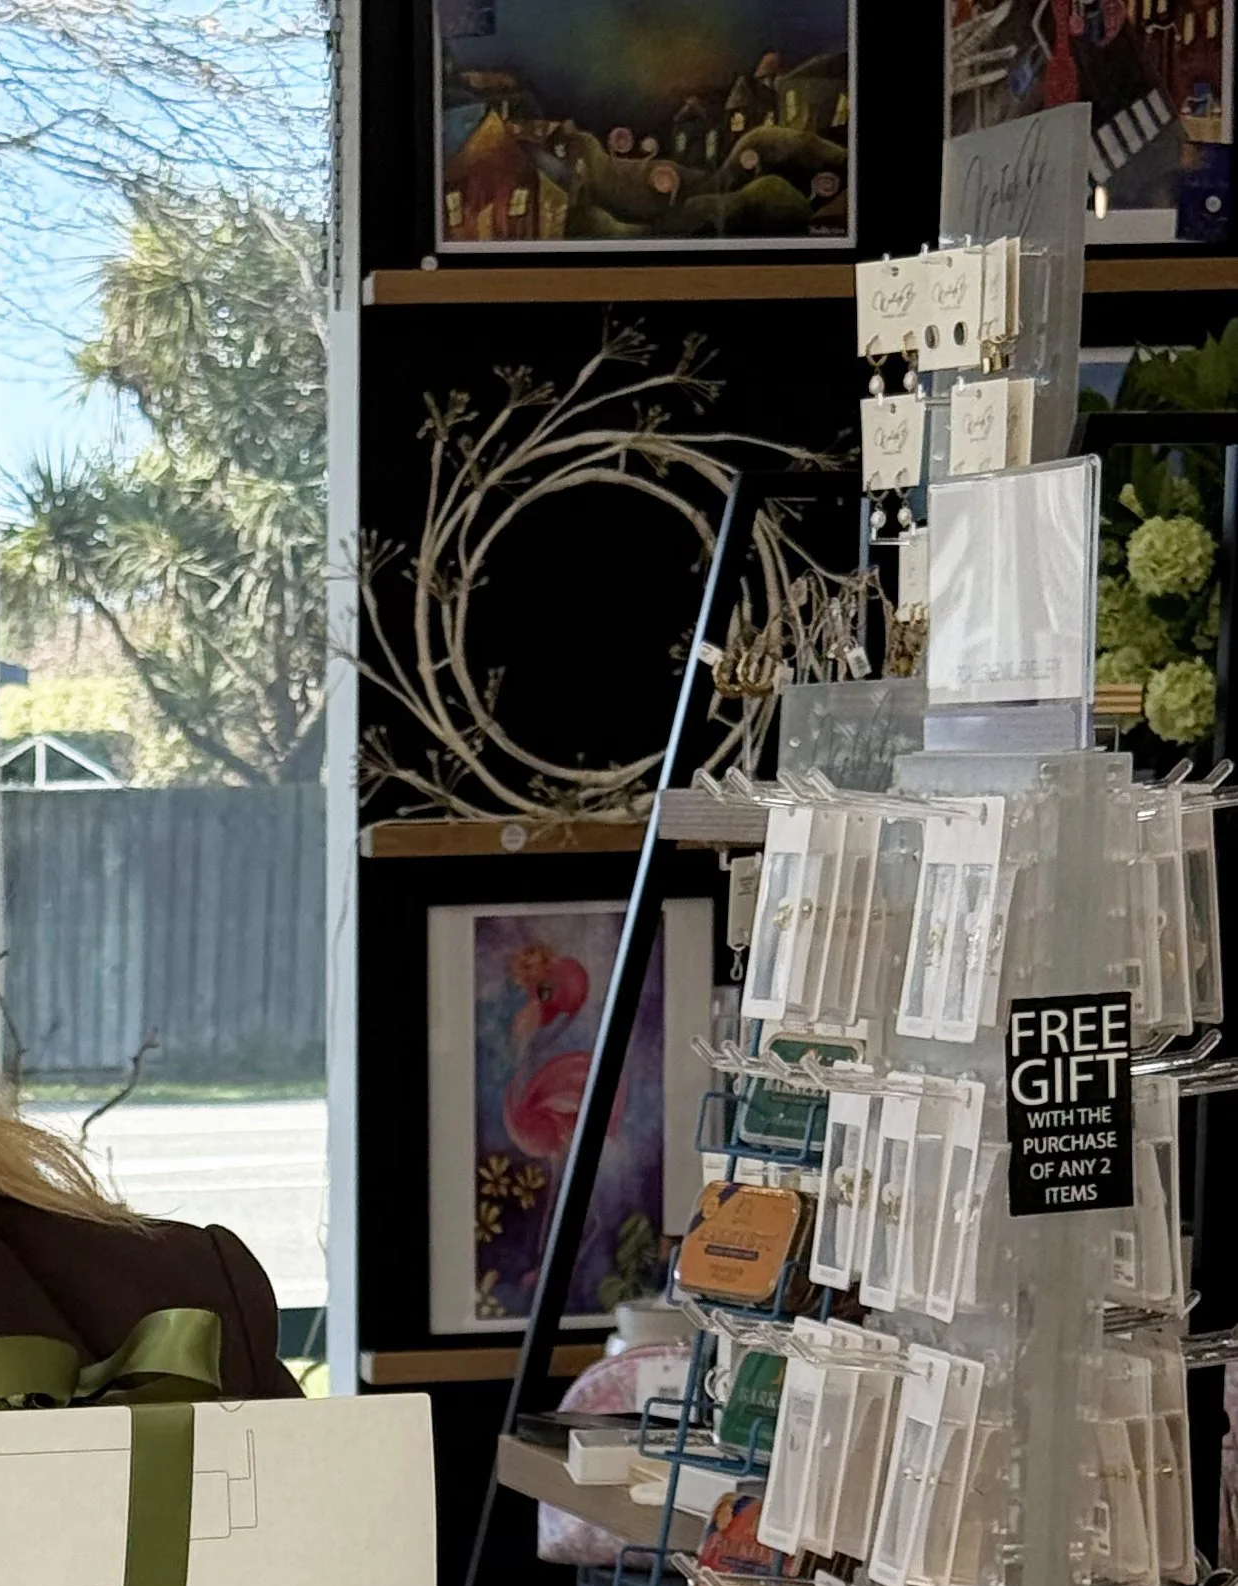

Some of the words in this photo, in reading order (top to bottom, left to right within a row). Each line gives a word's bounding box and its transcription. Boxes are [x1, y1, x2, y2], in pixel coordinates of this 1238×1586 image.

[1012, 1004, 1128, 1057] FREE
[1011, 1052, 1128, 1106] GIFT
[1026, 1108, 1074, 1129] WITH
[1077, 1105, 1112, 1125] THE
[1022, 1131, 1118, 1155] PURCHASE
[1029, 1161, 1054, 1180] OF
[1058, 1158, 1096, 1179] ANY
[1099, 1157, 1112, 1175] 2
[1045, 1183, 1098, 1205] ITEMS
